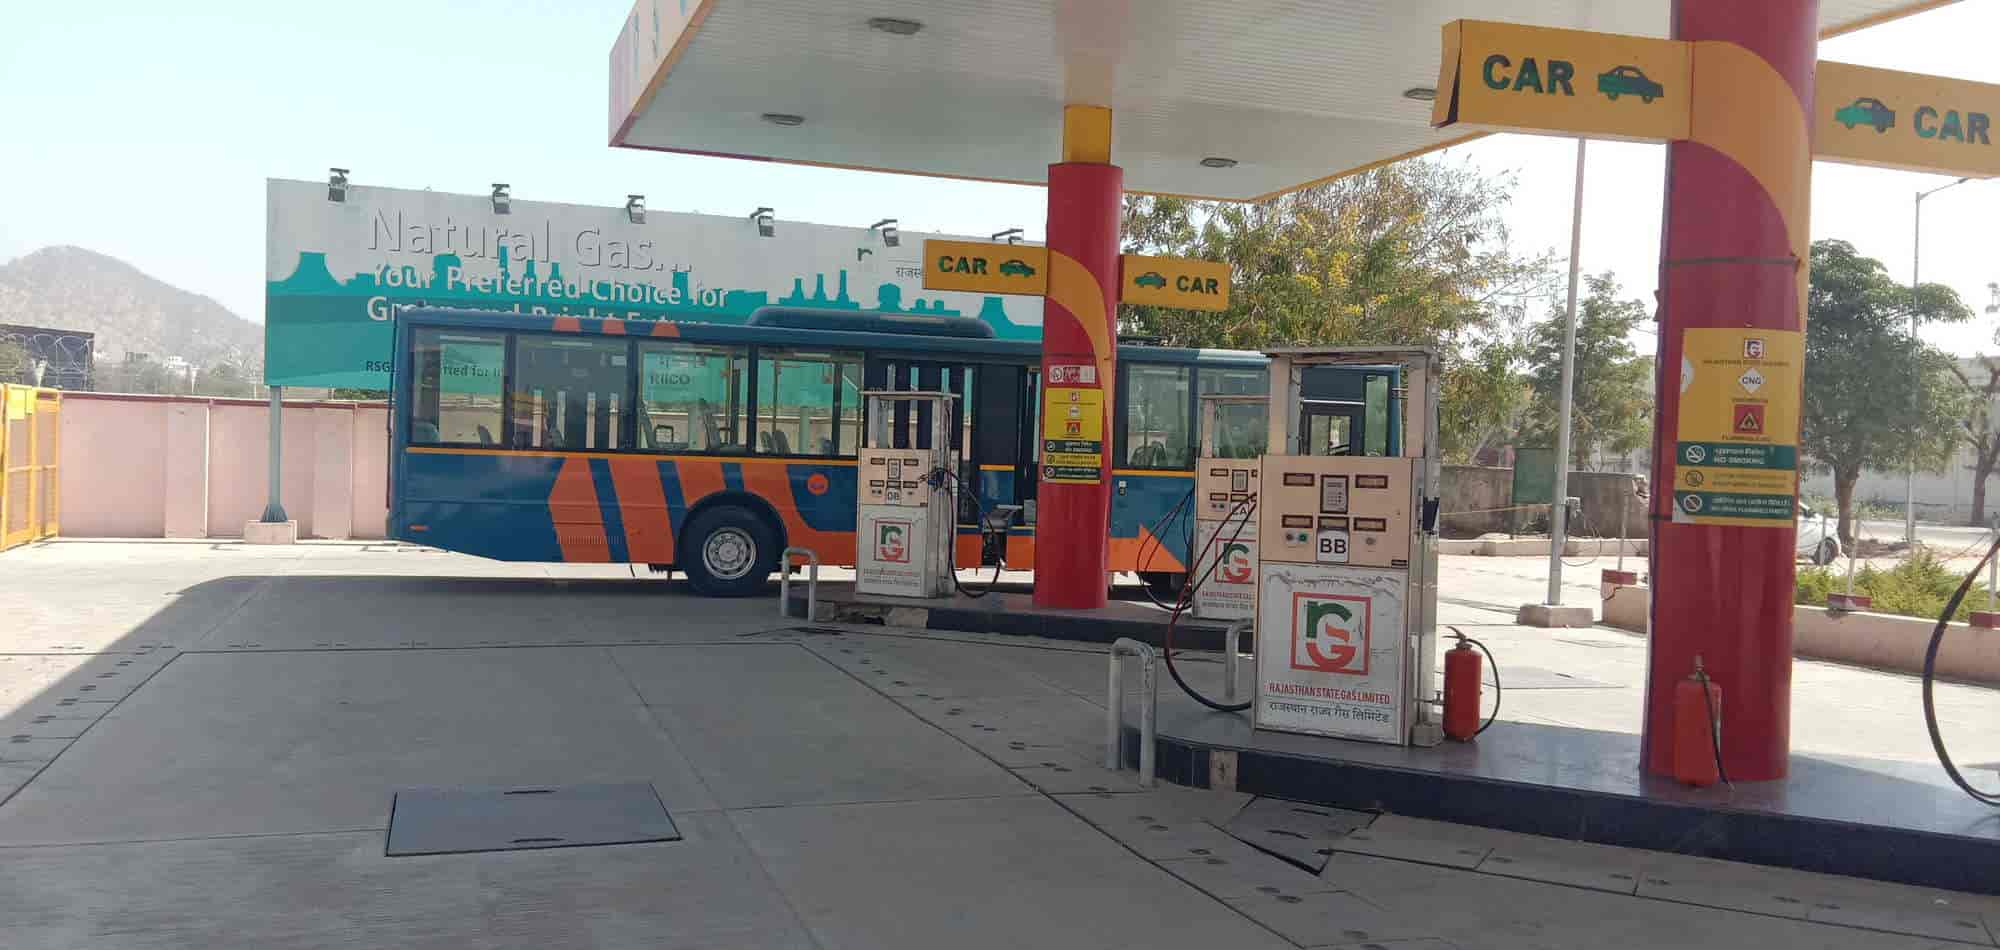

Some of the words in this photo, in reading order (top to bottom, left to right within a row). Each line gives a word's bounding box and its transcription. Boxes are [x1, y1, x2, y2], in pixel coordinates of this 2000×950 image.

[1482, 54, 1575, 96] CAR
[1913, 105, 1991, 145] CAR
[367, 206, 550, 264] Natural
[937, 255, 987, 276] CAR
[372, 263, 436, 289] Your
[446, 266, 582, 300] Preferred
[591, 274, 681, 305] Choice
[691, 281, 729, 308] for
[1176, 275, 1219, 296] CAR
[1742, 376, 1761, 385] CNG
[1319, 538, 1347, 554] BB
[1269, 682, 1316, 696] RAJASTHAN
[1316, 687, 1340, 699] STATE
[1342, 689, 1357, 701] GAS
[1357, 691, 1390, 705] LIMITED
